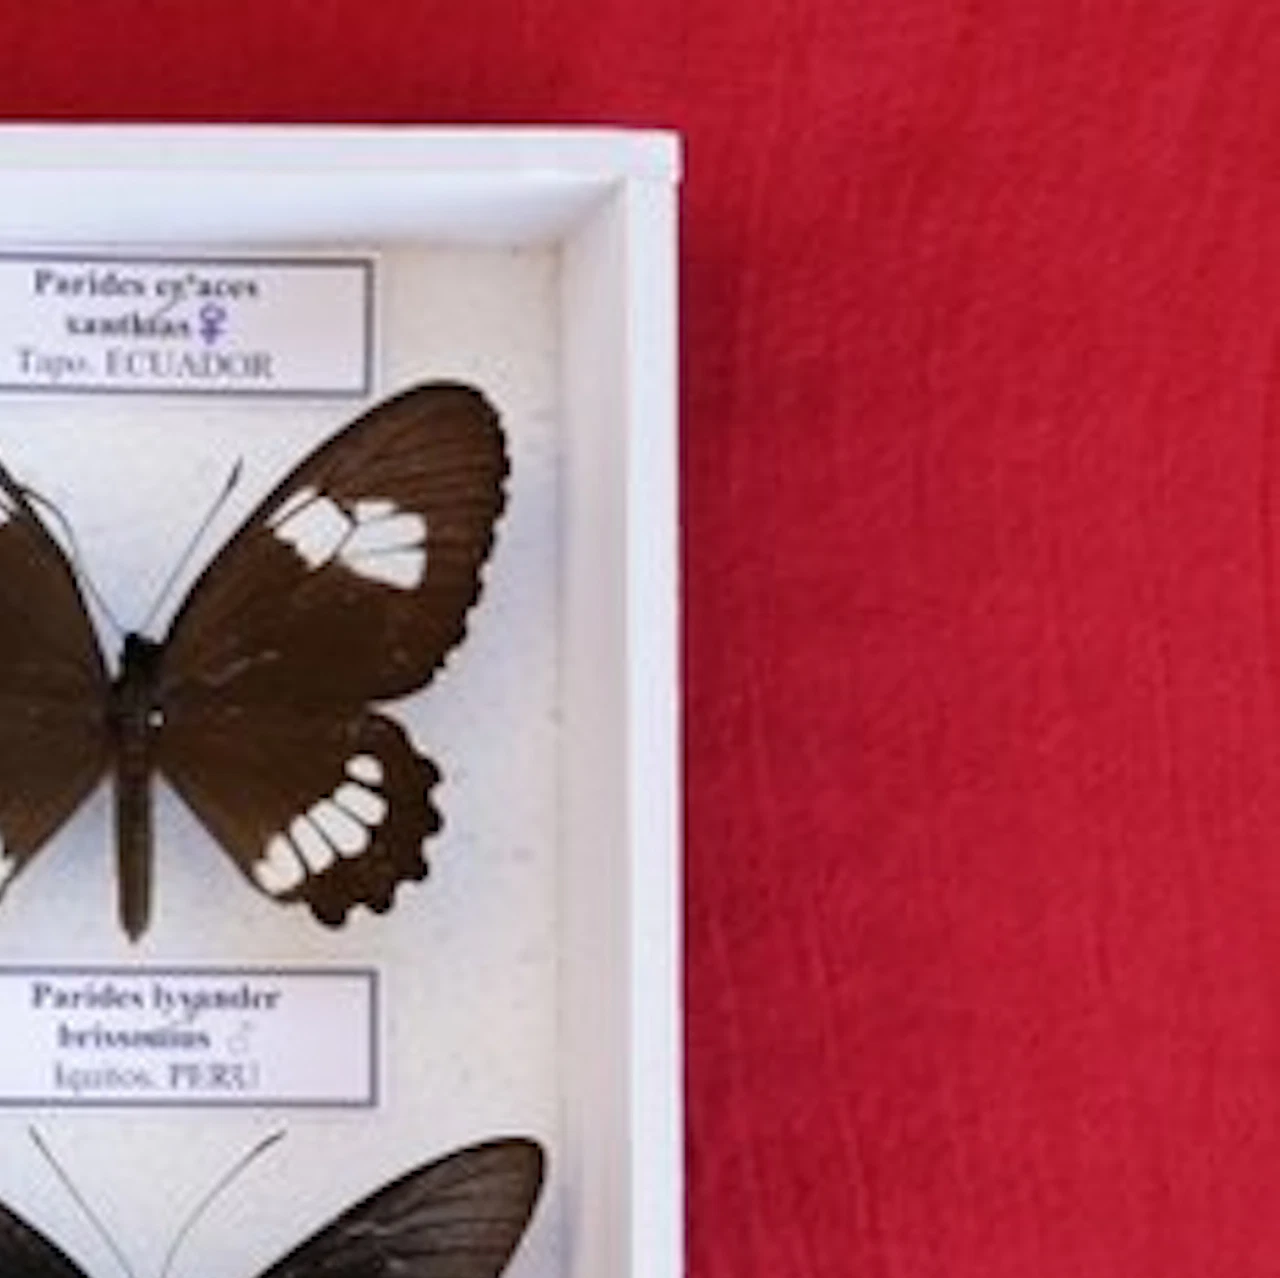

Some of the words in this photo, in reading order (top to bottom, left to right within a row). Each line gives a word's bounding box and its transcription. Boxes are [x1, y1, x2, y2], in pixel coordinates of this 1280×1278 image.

[35, 269, 146, 298] Parides
[106, 350, 274, 379] ECUADOR
[32, 983, 144, 1010] Parides
[168, 1063, 259, 1089] PERU
